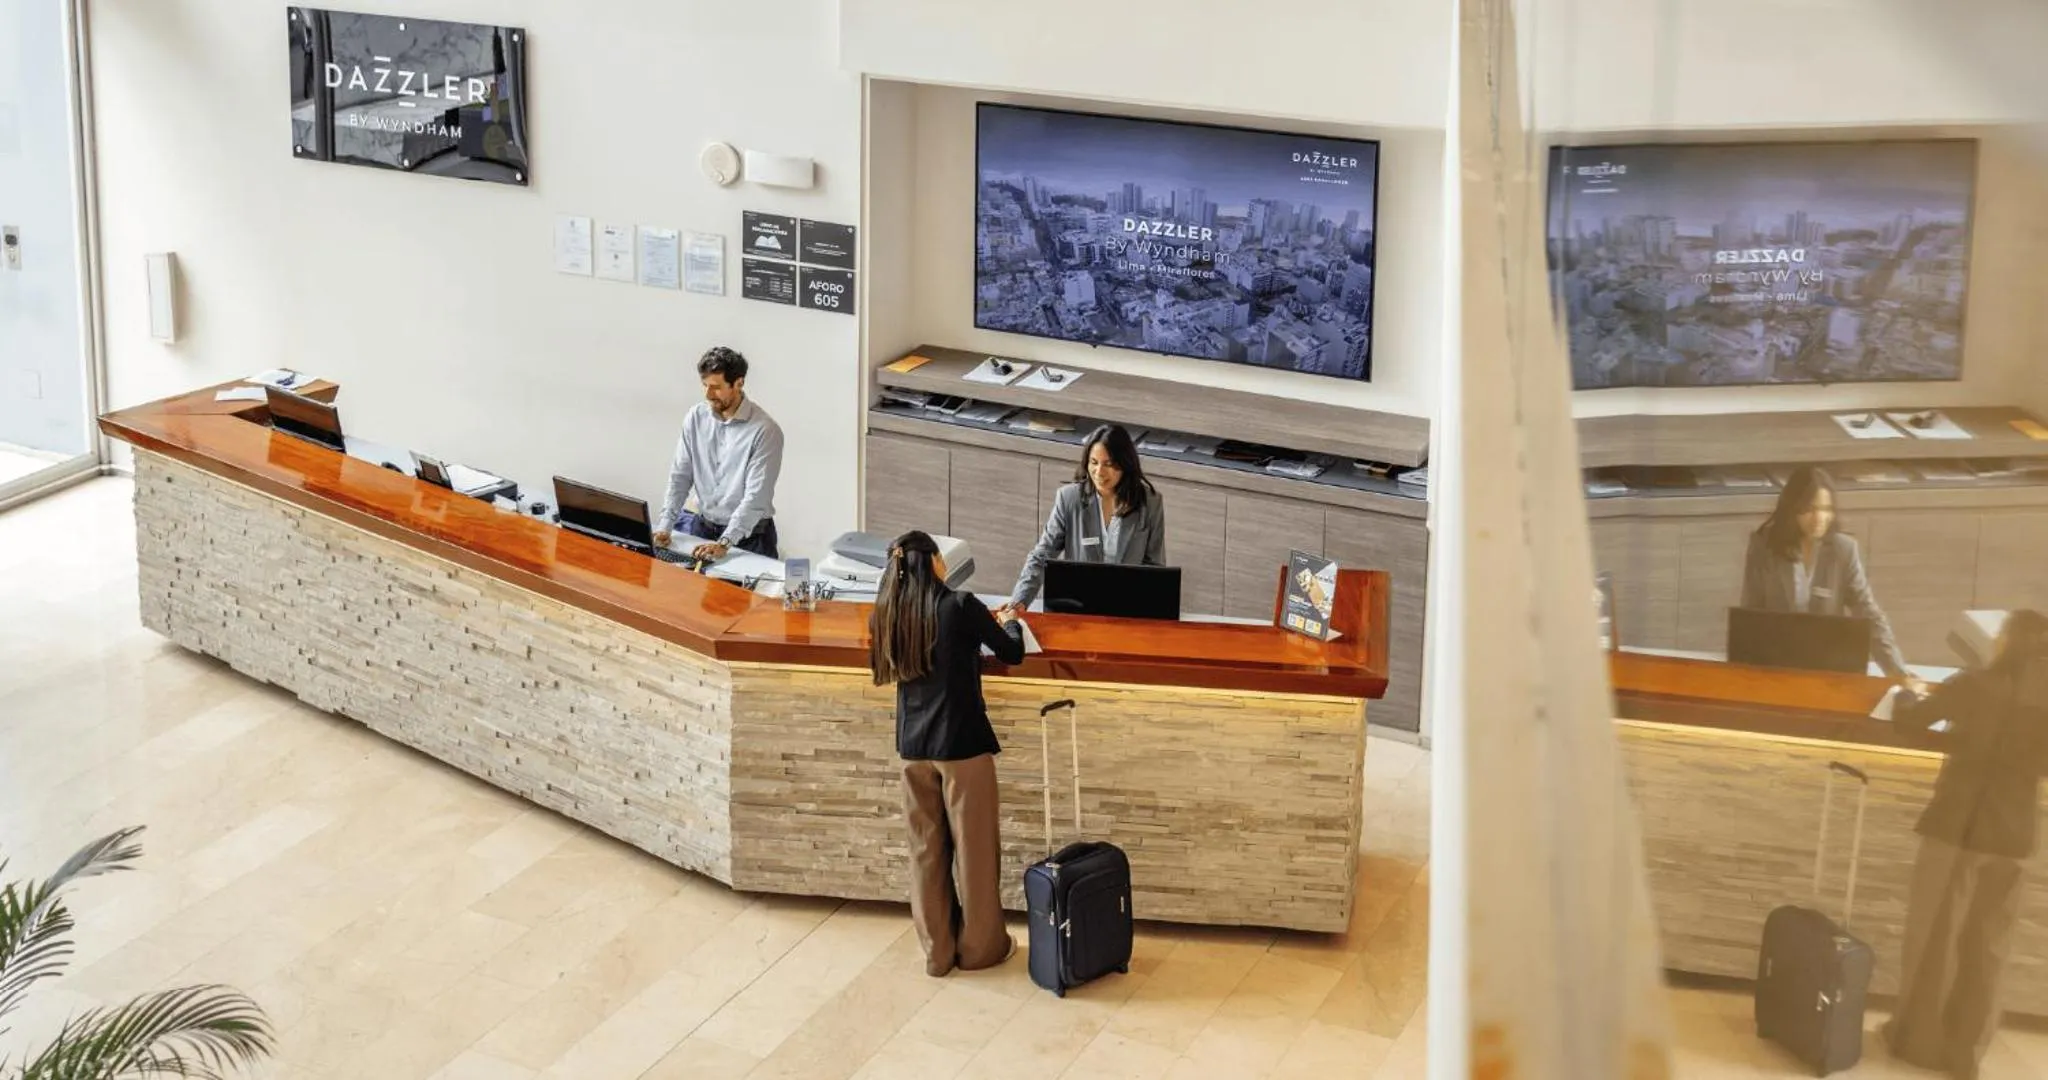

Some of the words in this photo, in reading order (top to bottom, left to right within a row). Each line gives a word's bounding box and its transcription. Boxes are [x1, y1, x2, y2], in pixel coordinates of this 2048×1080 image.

[325, 56, 487, 108] DAZZLER
[349, 113, 369, 127] BY
[376, 115, 463, 139] WYNDHAM
[1292, 151, 1358, 169] DAZZLER
[1123, 218, 1213, 242] DAZZLER
[1105, 236, 1128, 254] By
[1135, 240, 1230, 264] Wyndham
[1118, 258, 1146, 272] Lima
[1156, 265, 1215, 280] Miraflores
[808, 280, 845, 294] AFORO
[814, 293, 839, 308] 605
